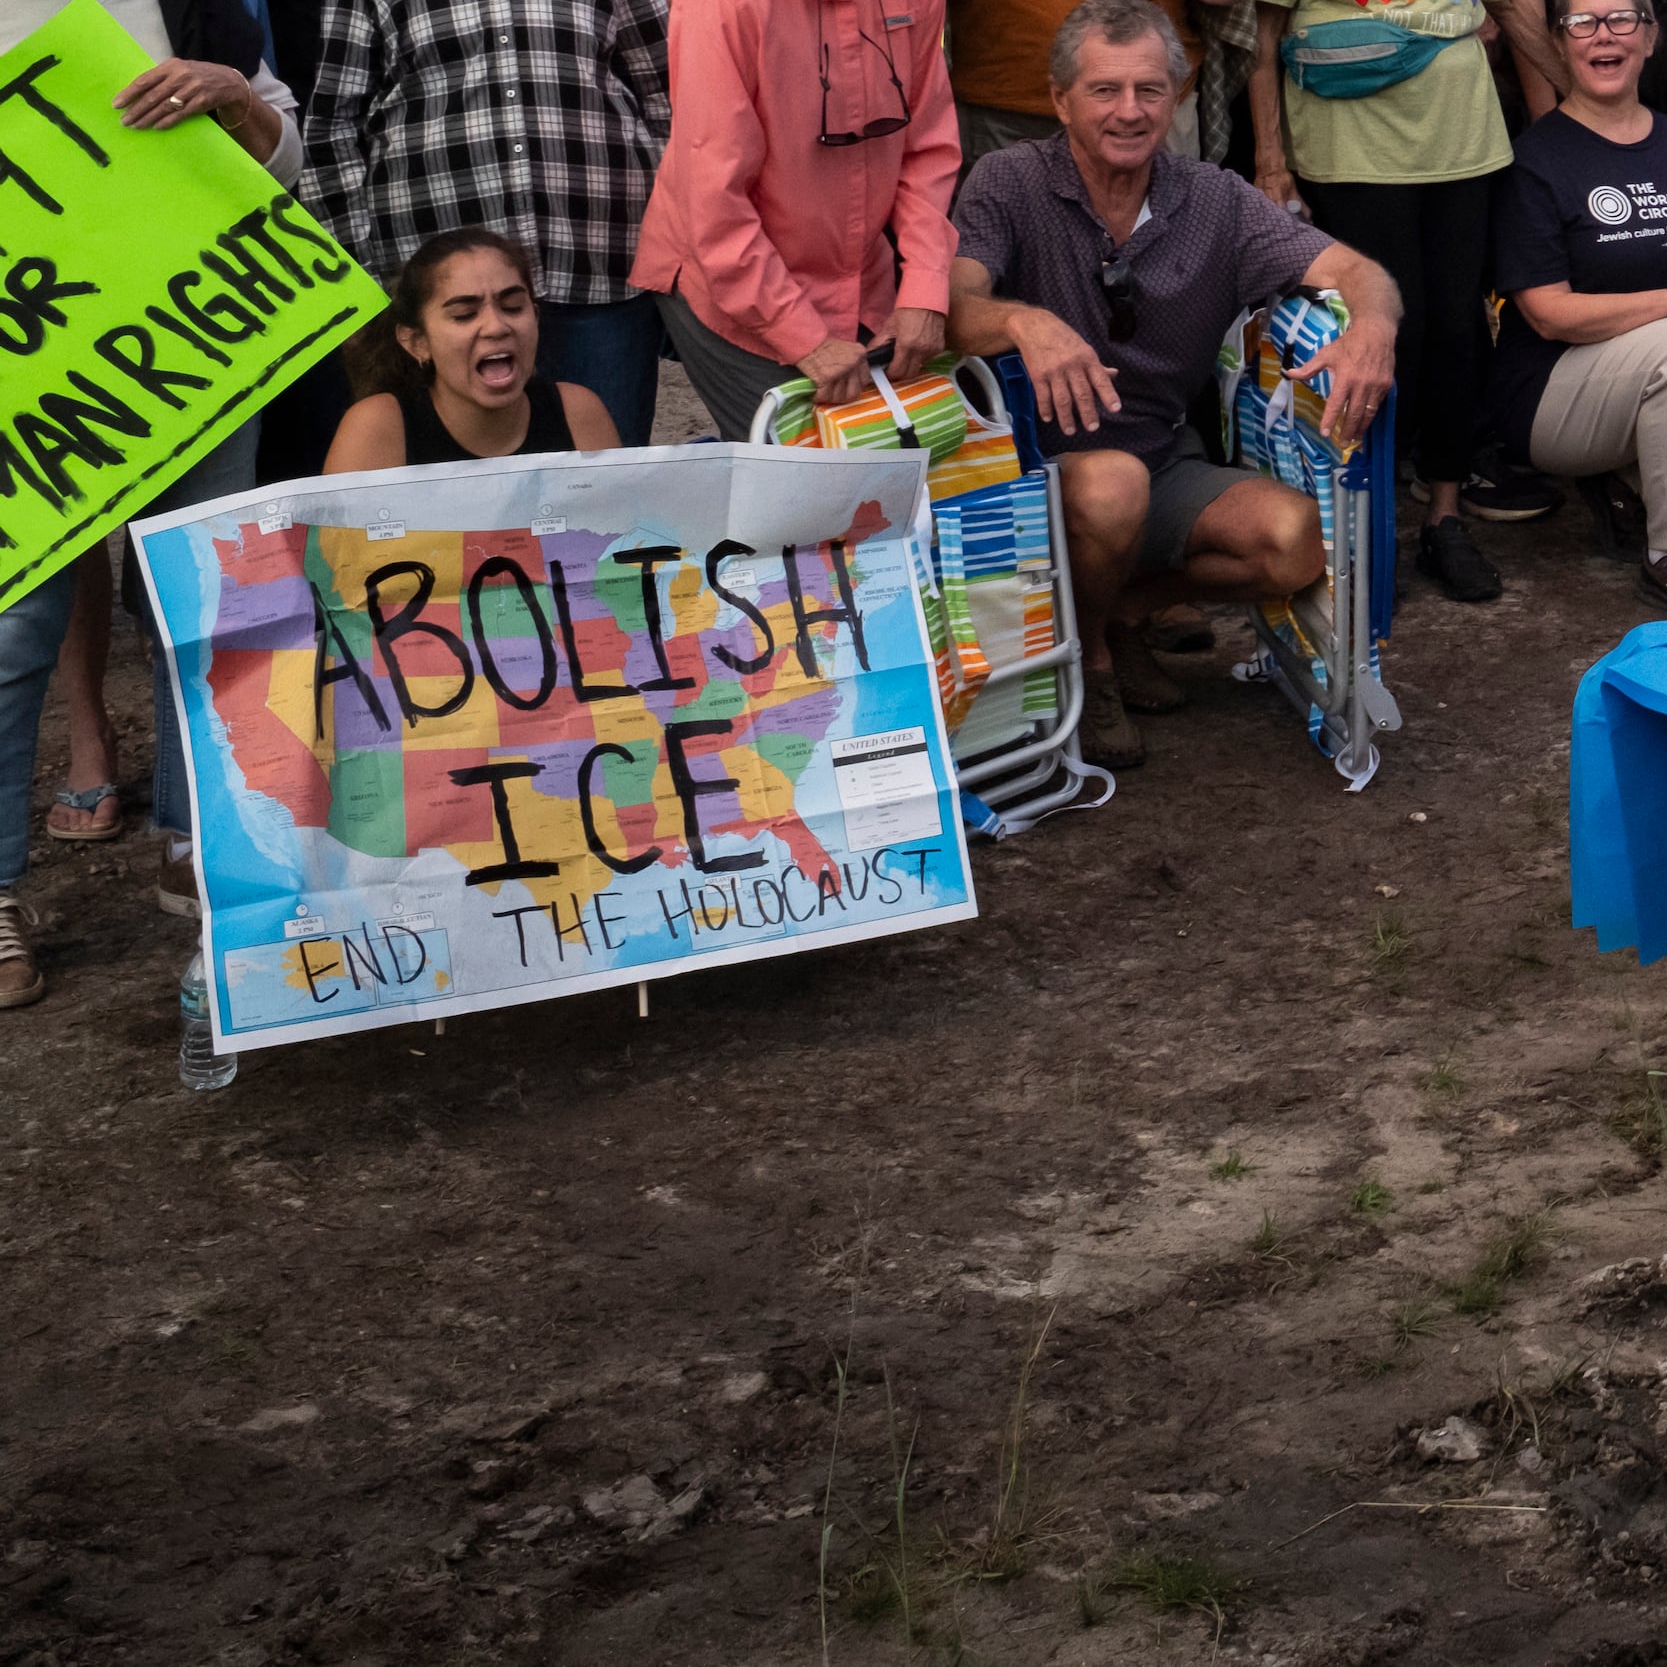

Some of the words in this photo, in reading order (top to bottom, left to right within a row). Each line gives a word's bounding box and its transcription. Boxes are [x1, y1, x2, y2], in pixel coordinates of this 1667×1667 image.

[1596, 230, 1632, 243] Jewish
[1634, 227, 1665, 238] culture
[1627, 183, 1656, 194] THE
[94, 192, 352, 411] RIGHTS
[309, 537, 874, 742] ABOLISH
[447, 719, 765, 889] ICE
[842, 740, 879, 752] UNITED
[880, 732, 914, 745] STATES
[301, 924, 427, 1004] END
[490, 892, 629, 970] THE
[661, 847, 944, 941] HOLOCAUST
